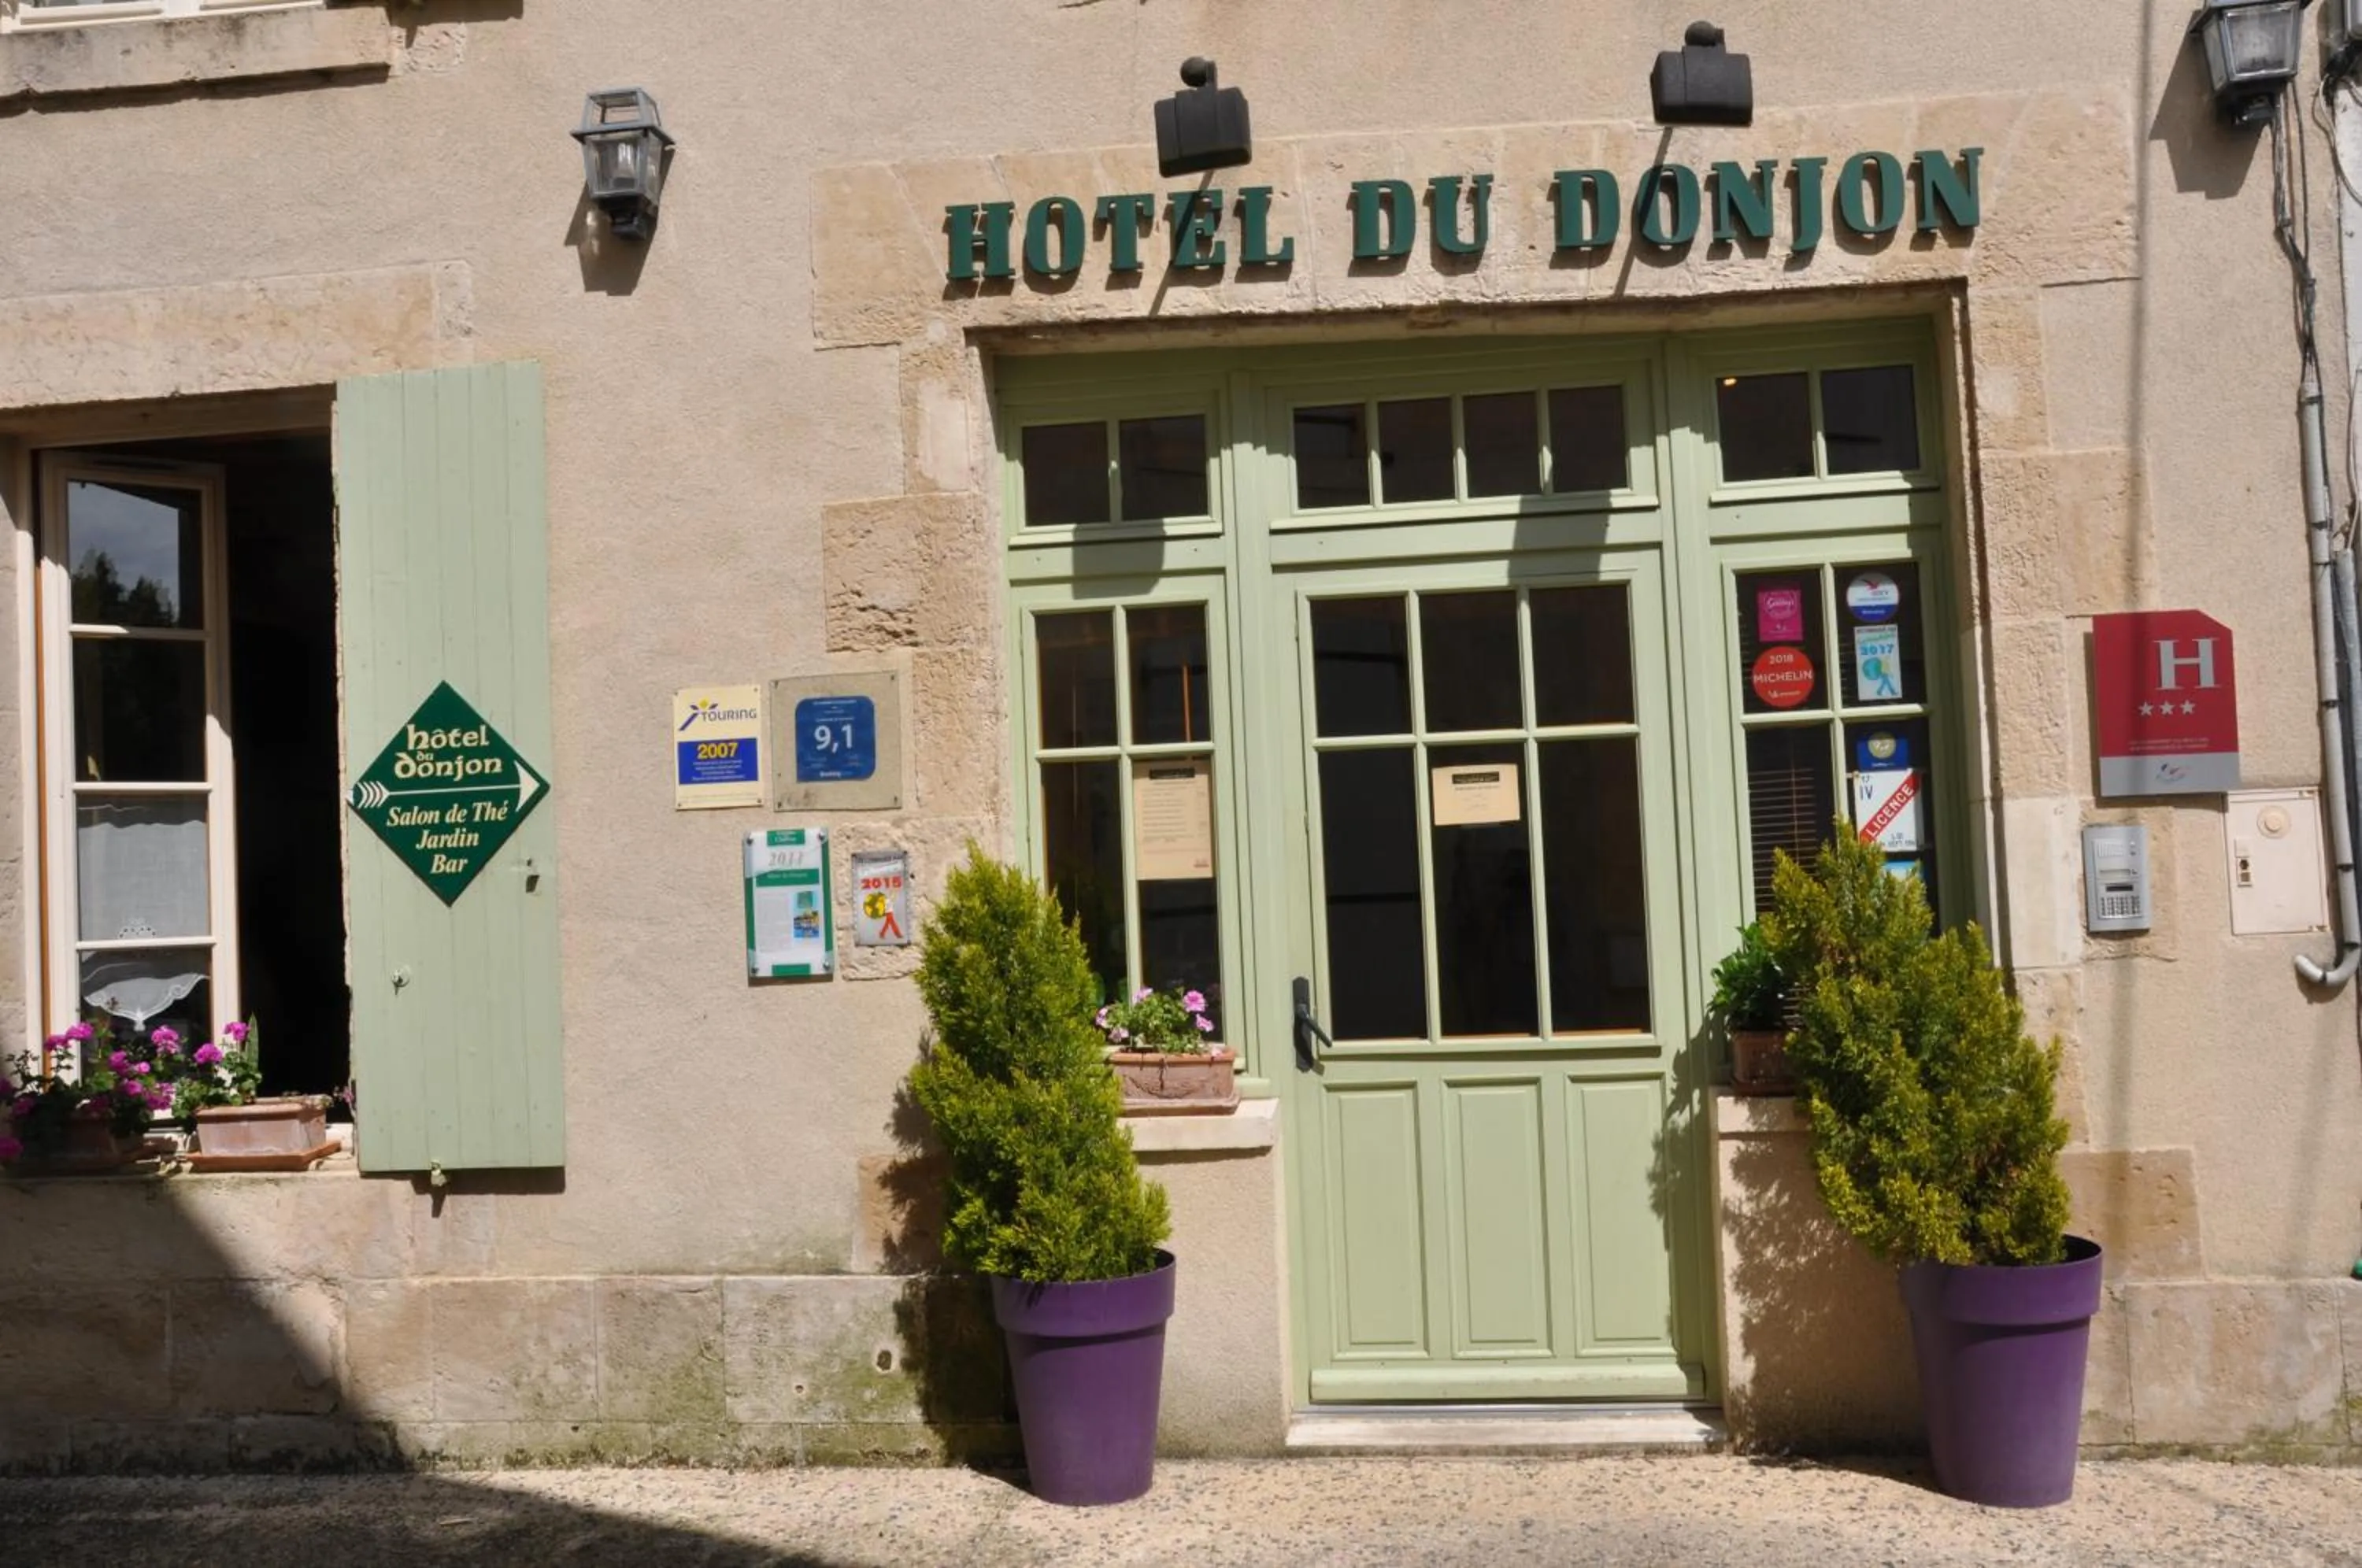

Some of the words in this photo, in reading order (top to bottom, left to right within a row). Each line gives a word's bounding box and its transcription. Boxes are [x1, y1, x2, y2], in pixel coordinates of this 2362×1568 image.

[944, 186, 1294, 279] HOTEL
[1351, 173, 1494, 258] DU
[1553, 147, 1984, 254] DONJON
[1753, 670, 1813, 683] MICHELIN
[2153, 637, 2221, 690] H
[702, 708, 757, 722] TOURING
[406, 723, 490, 750] hôtel
[814, 724, 852, 753] 9,1
[697, 742, 739, 760] 2007
[394, 752, 502, 781] donjon
[387, 805, 440, 827] Salon
[445, 803, 467, 824] de
[472, 800, 509, 822] Thé
[1865, 783, 1914, 838] LICENCE
[416, 828, 479, 850] Jardin
[431, 854, 469, 875] Bar
